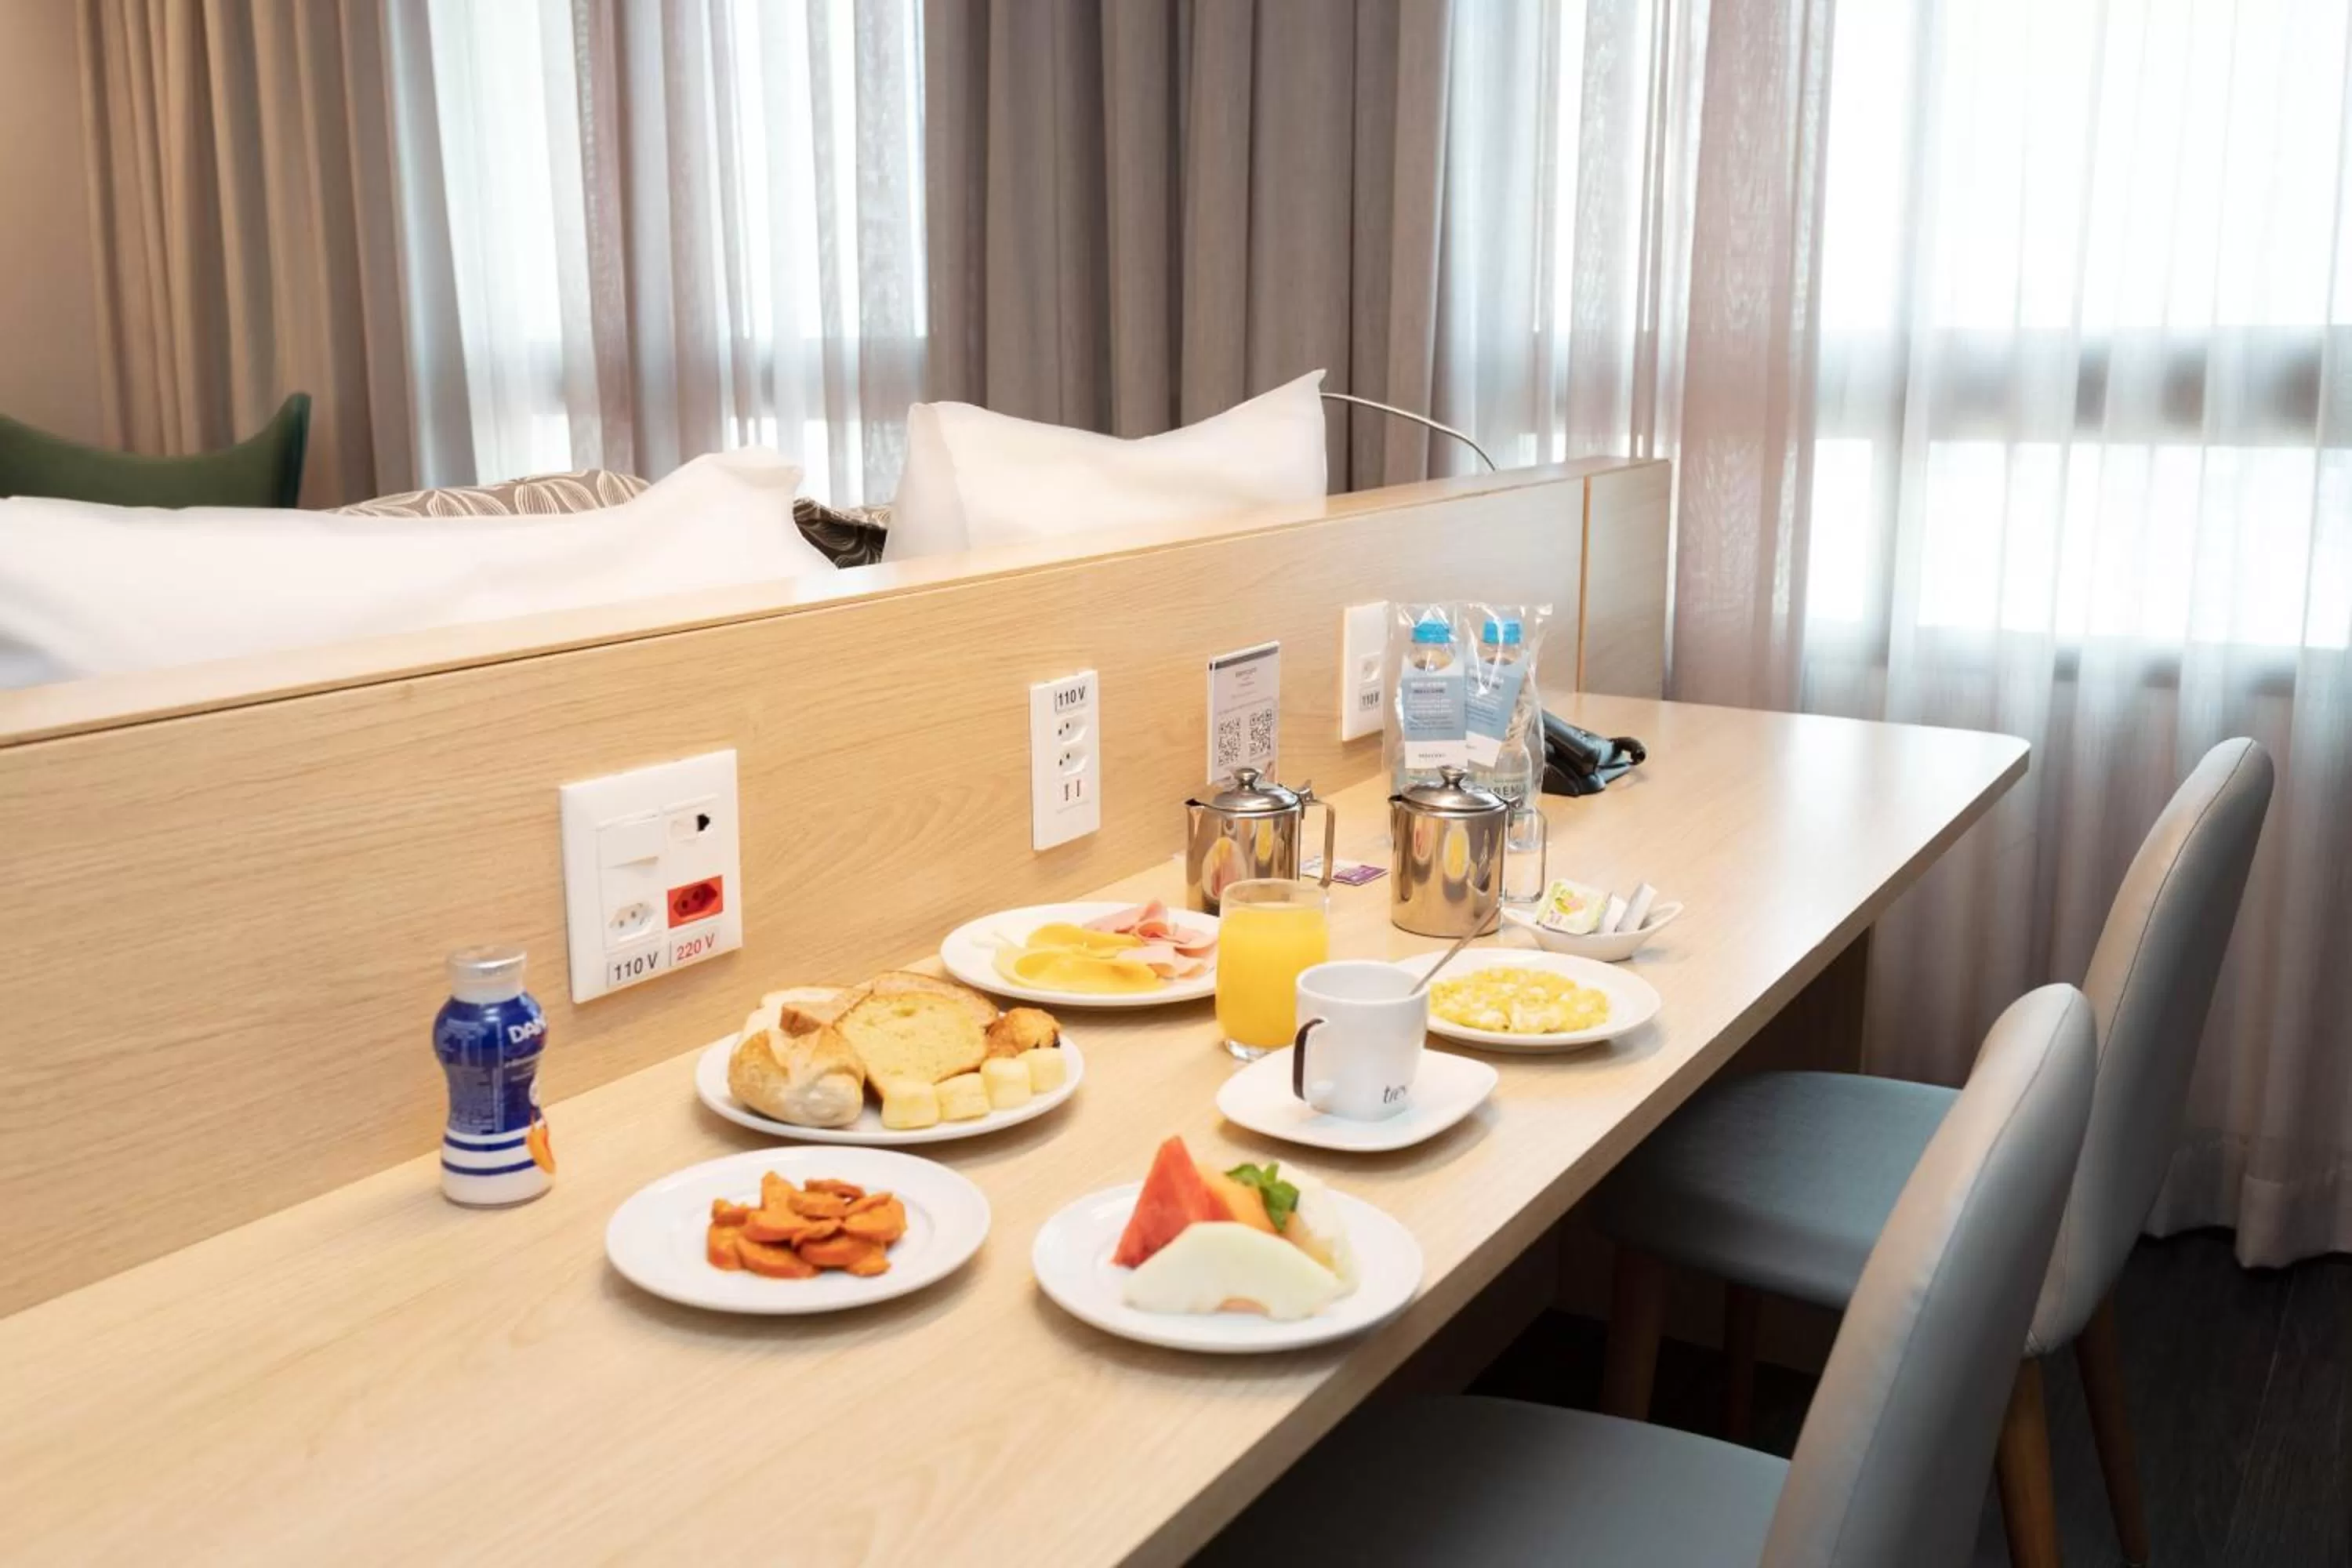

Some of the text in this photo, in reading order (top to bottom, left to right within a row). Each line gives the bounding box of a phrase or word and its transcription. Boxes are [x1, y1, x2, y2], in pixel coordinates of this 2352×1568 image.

[677, 931, 715, 960] 220 V
[614, 951, 659, 981] 110 V
